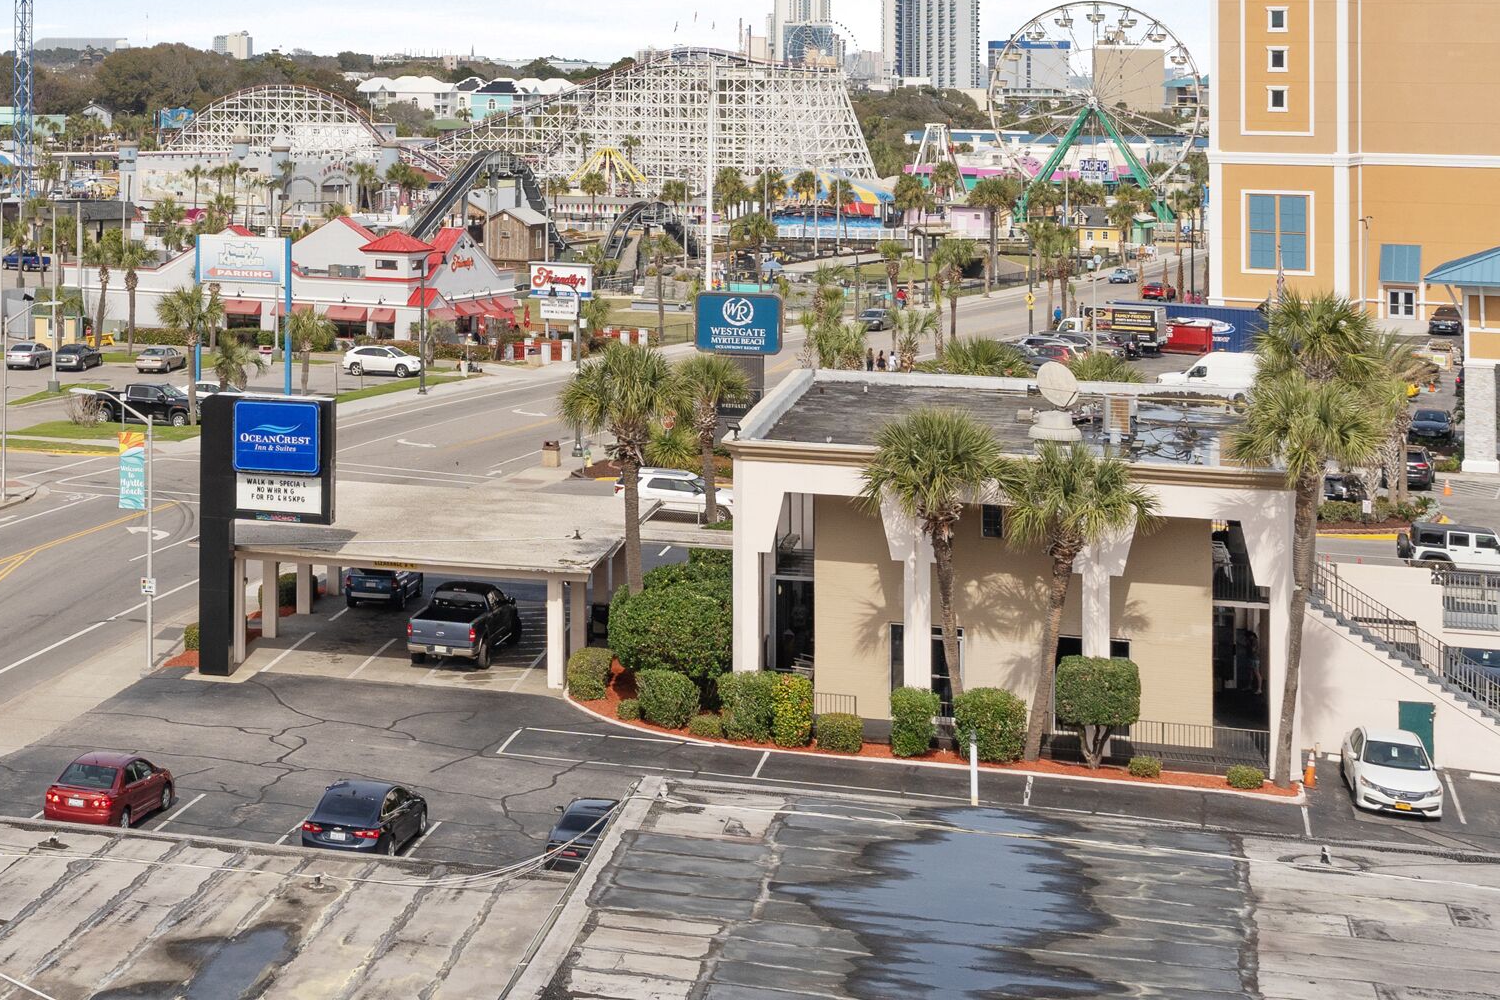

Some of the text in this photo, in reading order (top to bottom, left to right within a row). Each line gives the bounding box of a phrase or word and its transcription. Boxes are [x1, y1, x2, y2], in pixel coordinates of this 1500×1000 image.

[219, 252, 264, 268] Kingdom
[217, 270, 272, 278] PARKING
[532, 267, 587, 289] Friendly's
[710, 327, 766, 337] WESTGATE
[741, 338, 765, 346] BEACH
[255, 443, 267, 451] Inn
[120, 465, 143, 473] Welcome
[120, 480, 144, 488] Myrtle
